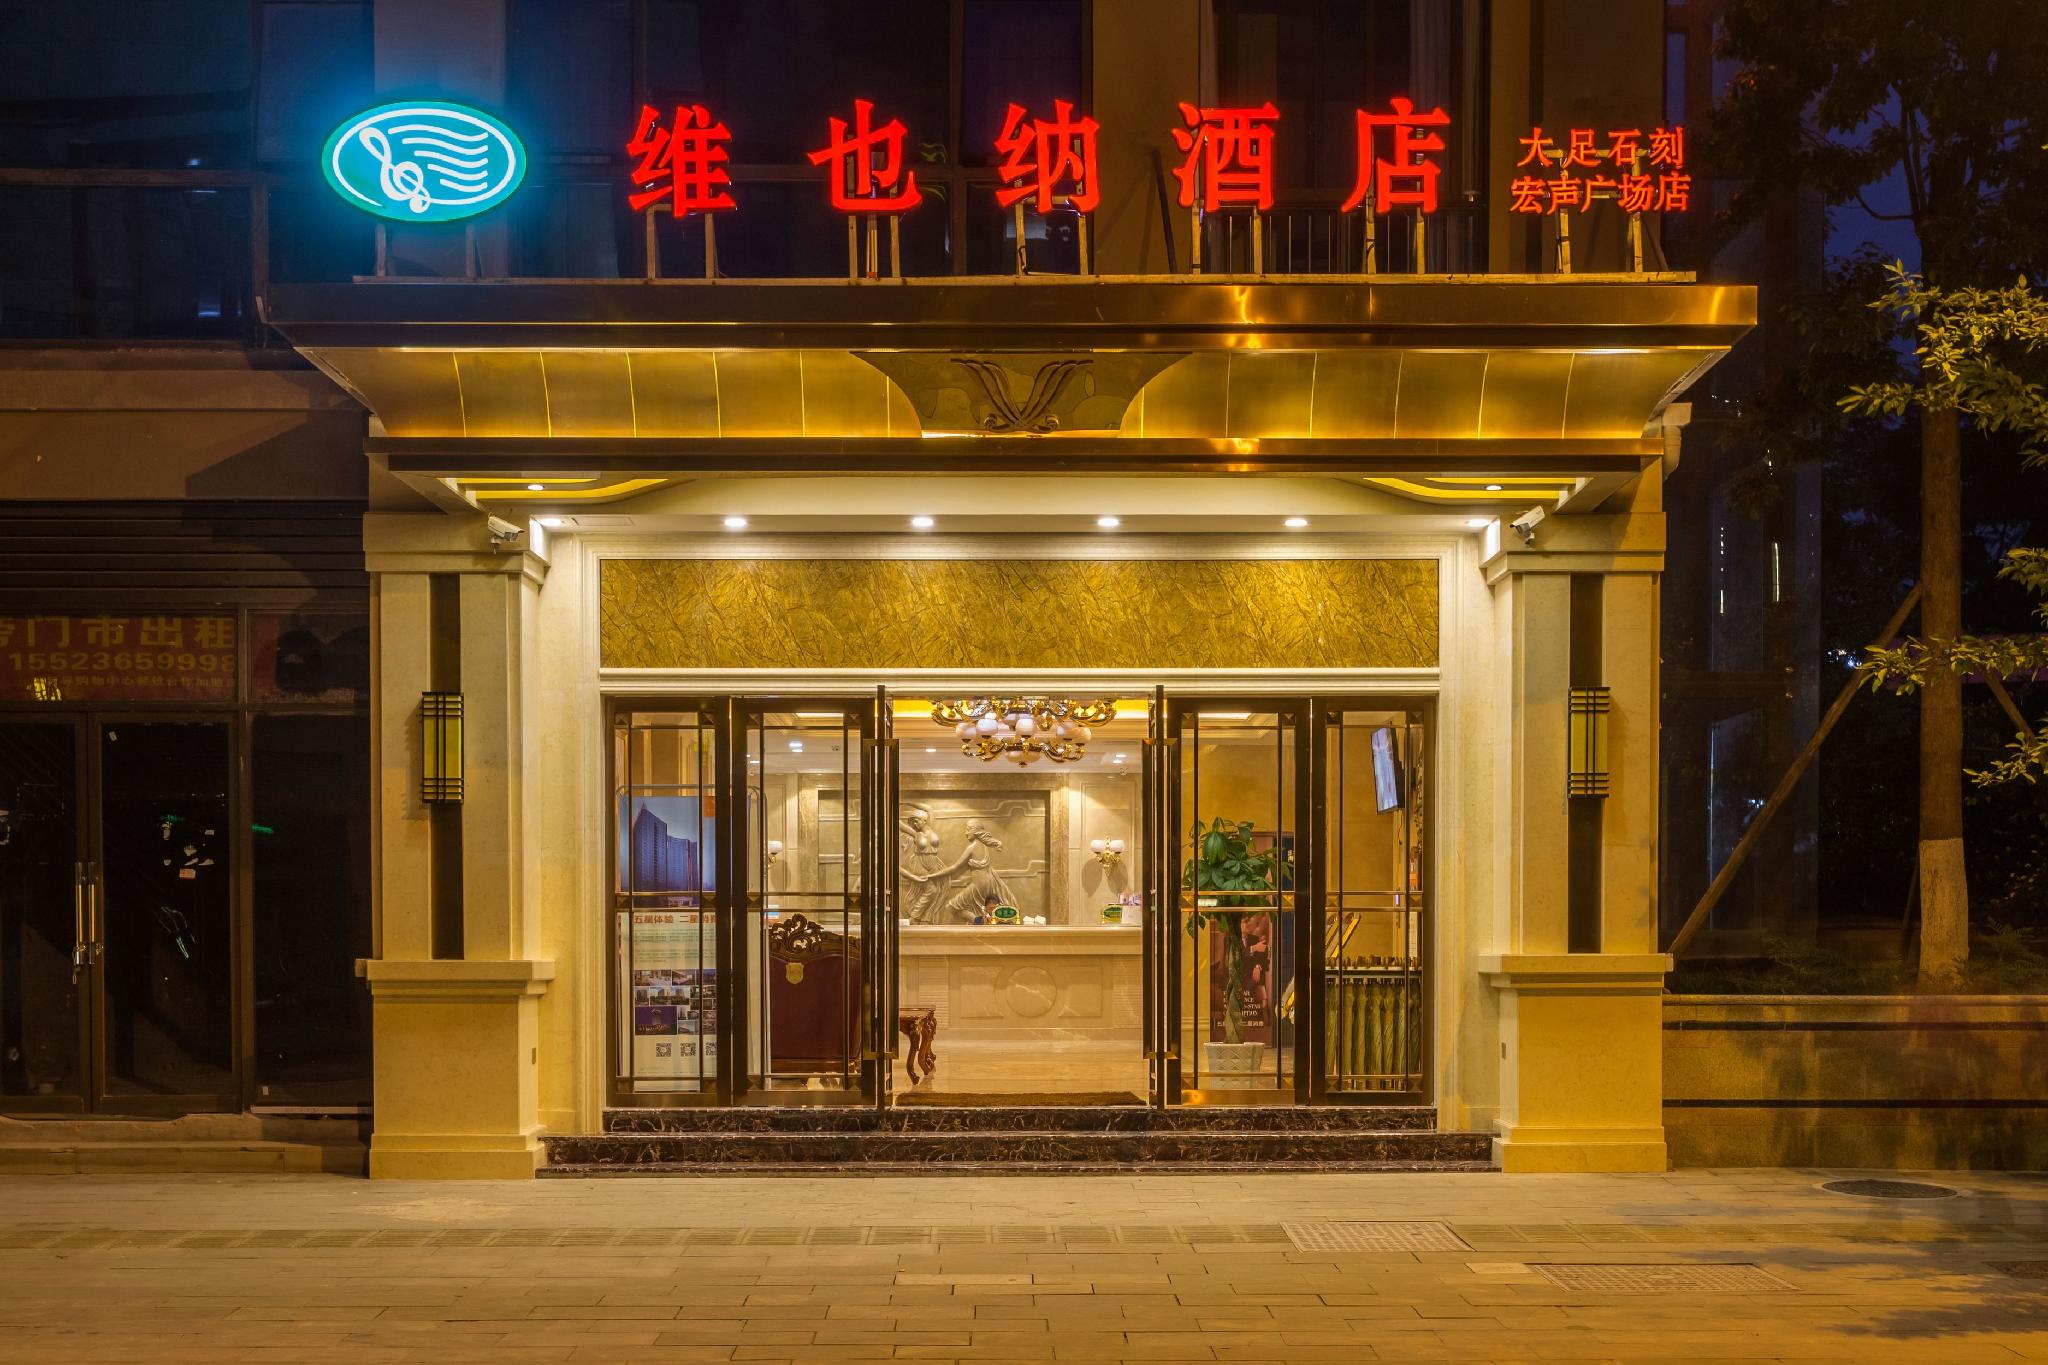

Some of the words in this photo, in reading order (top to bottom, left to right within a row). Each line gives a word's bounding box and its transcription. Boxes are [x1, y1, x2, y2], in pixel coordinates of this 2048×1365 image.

[626, 98, 1451, 218] 维也纳酒店
[1517, 126, 1686, 169] 大足石刻
[1509, 170, 1693, 215] 宏声广场店
